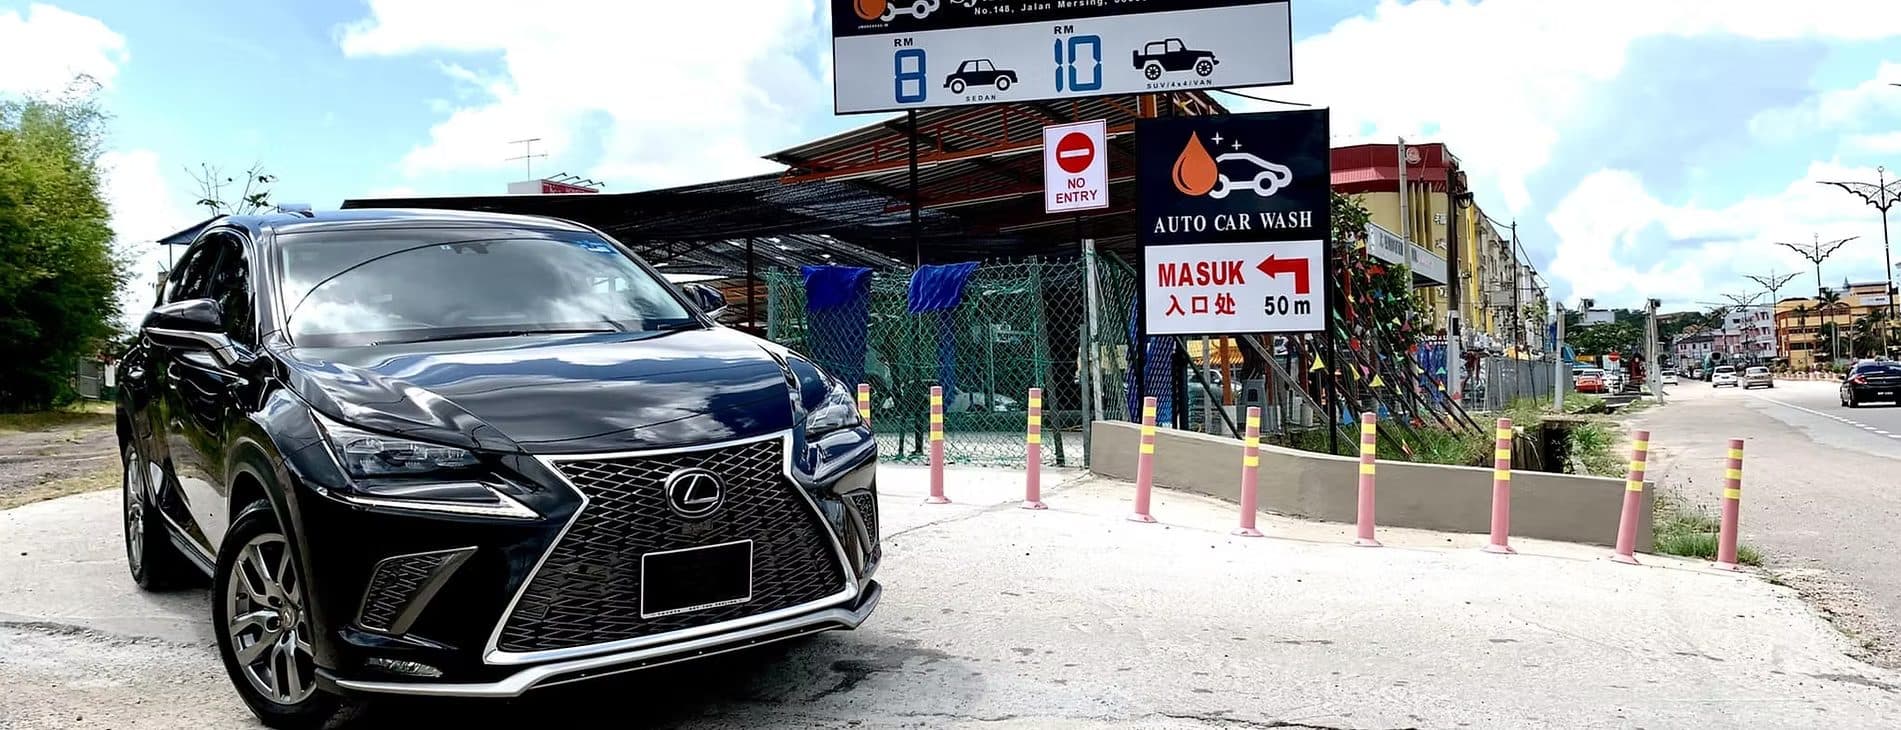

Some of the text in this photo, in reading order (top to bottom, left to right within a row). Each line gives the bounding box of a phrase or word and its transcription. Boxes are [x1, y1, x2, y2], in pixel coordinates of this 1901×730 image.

[1020, 3, 1051, 11] Jalan
[1054, 25, 1073, 34] RM
[894, 38, 913, 47] RM
[1054, 35, 1102, 93] 10
[894, 49, 926, 103] 8
[965, 94, 996, 102] SEDAN
[1067, 177, 1086, 189] NO
[1055, 189, 1098, 204] ENTRY
[1154, 211, 1313, 234] AUTO CAR WASH
[1158, 260, 1246, 287] MASUK
[1165, 293, 1236, 317] 入口处
[1264, 296, 1311, 316] 50 m
